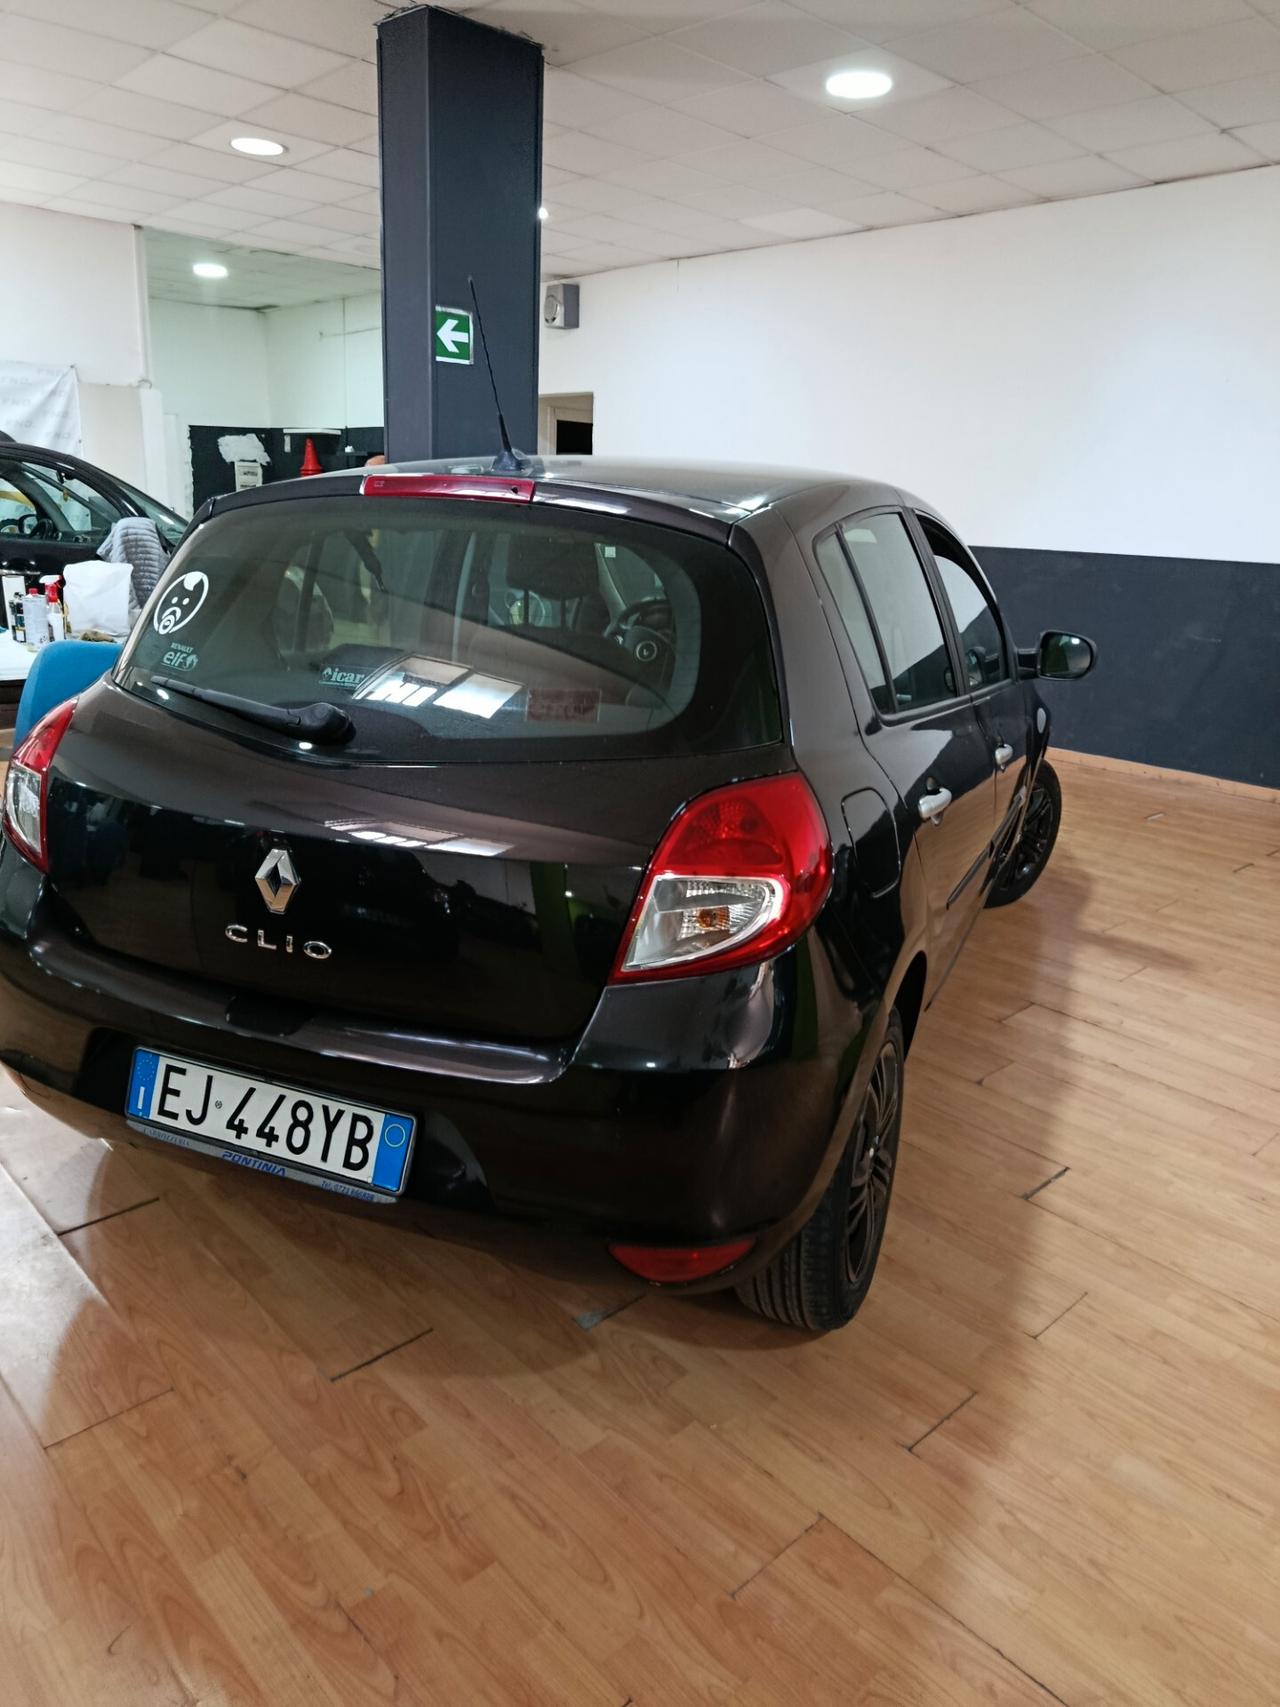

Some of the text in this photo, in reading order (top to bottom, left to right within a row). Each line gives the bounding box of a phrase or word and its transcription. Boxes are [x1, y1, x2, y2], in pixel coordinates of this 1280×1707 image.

[163, 651, 188, 666] elf
[225, 924, 332, 960] CLIO
[222, 1150, 286, 1177] PONTINIA
